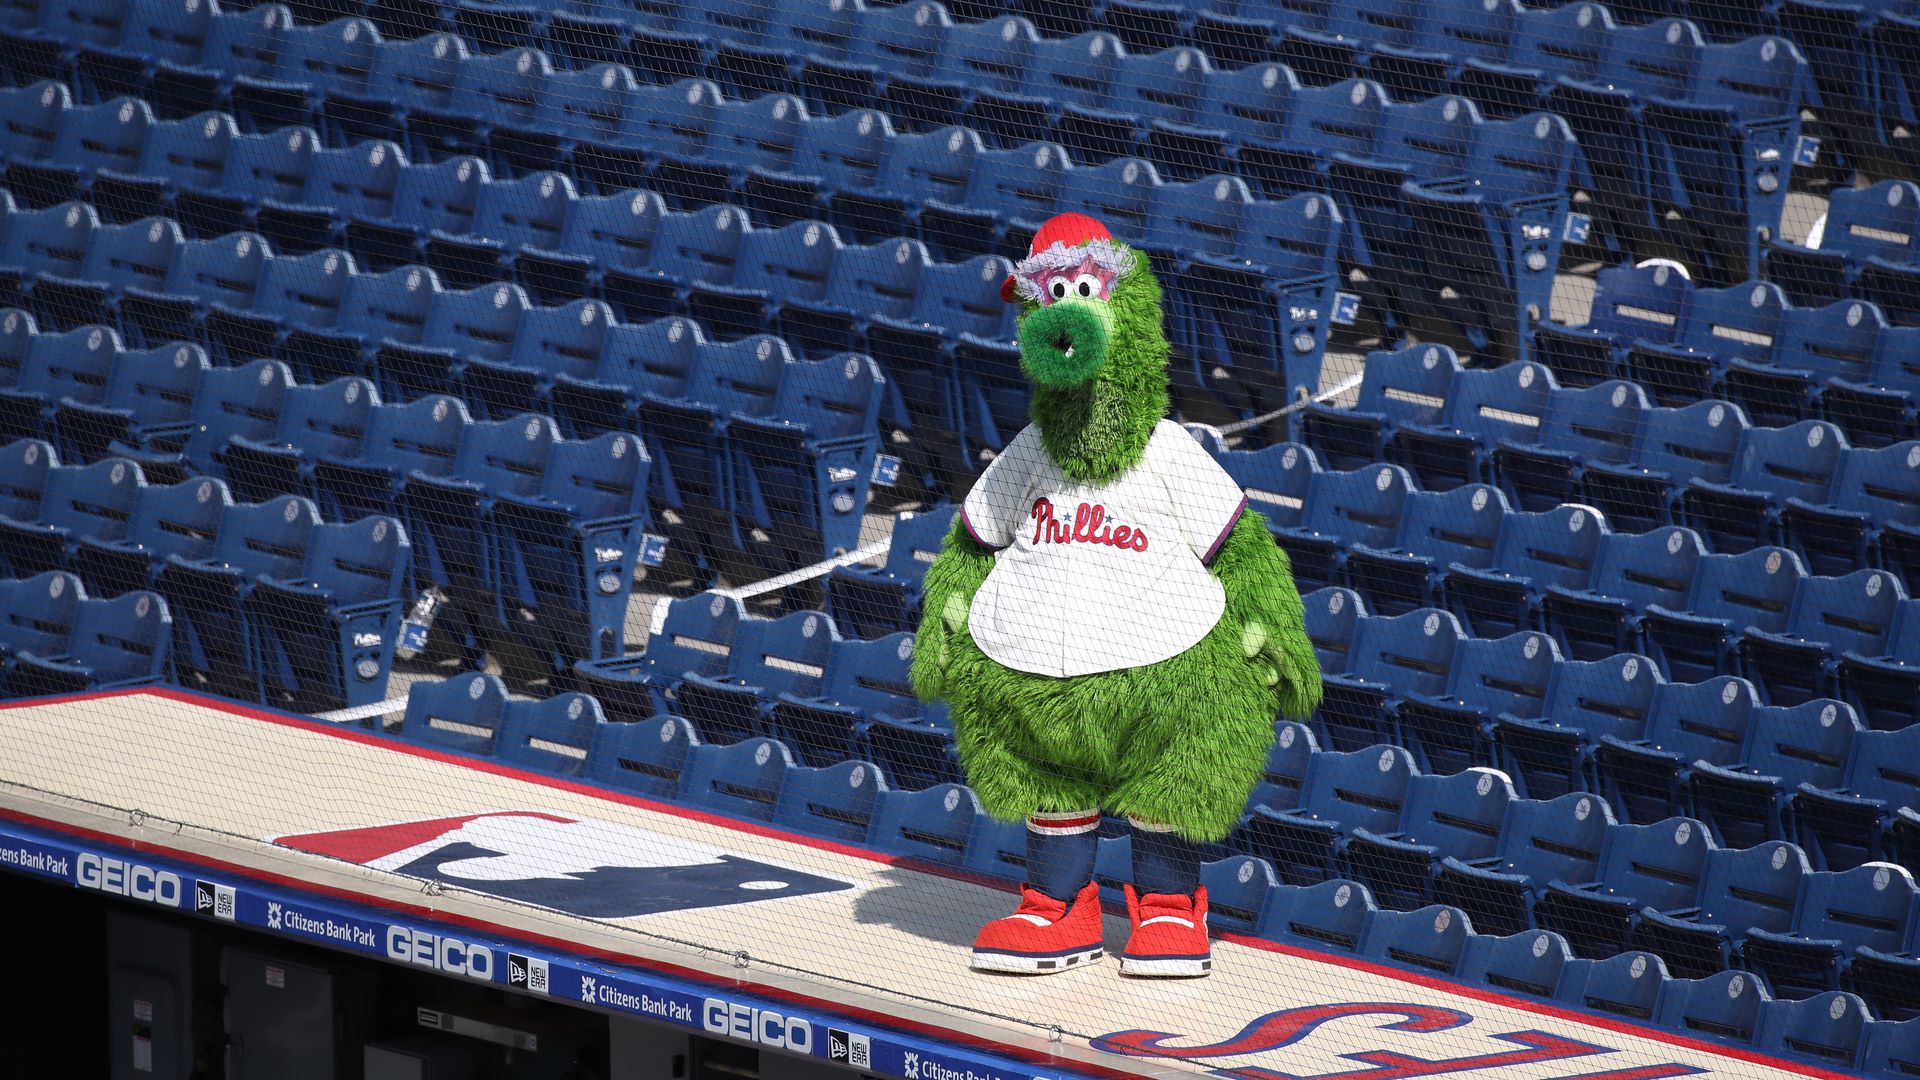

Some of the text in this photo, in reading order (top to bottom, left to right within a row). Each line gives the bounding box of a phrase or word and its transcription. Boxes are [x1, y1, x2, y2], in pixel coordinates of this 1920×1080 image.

[1031, 497, 1148, 552] Phillies
[0, 848, 68, 876] ens Bank Park
[76, 852, 181, 908] GEICO
[217, 892, 233, 905] NEW
[217, 903, 232, 915] ERA
[284, 910, 376, 947] Citizens Bank Park
[387, 925, 493, 981] GEICO
[531, 966, 546, 979] NEW
[531, 977, 546, 990] ERA
[599, 985, 692, 1022] Citizens Bank Park
[703, 997, 812, 1055] GEICO
[851, 1051, 868, 1065] ERA
[852, 1041, 868, 1054] NEW
